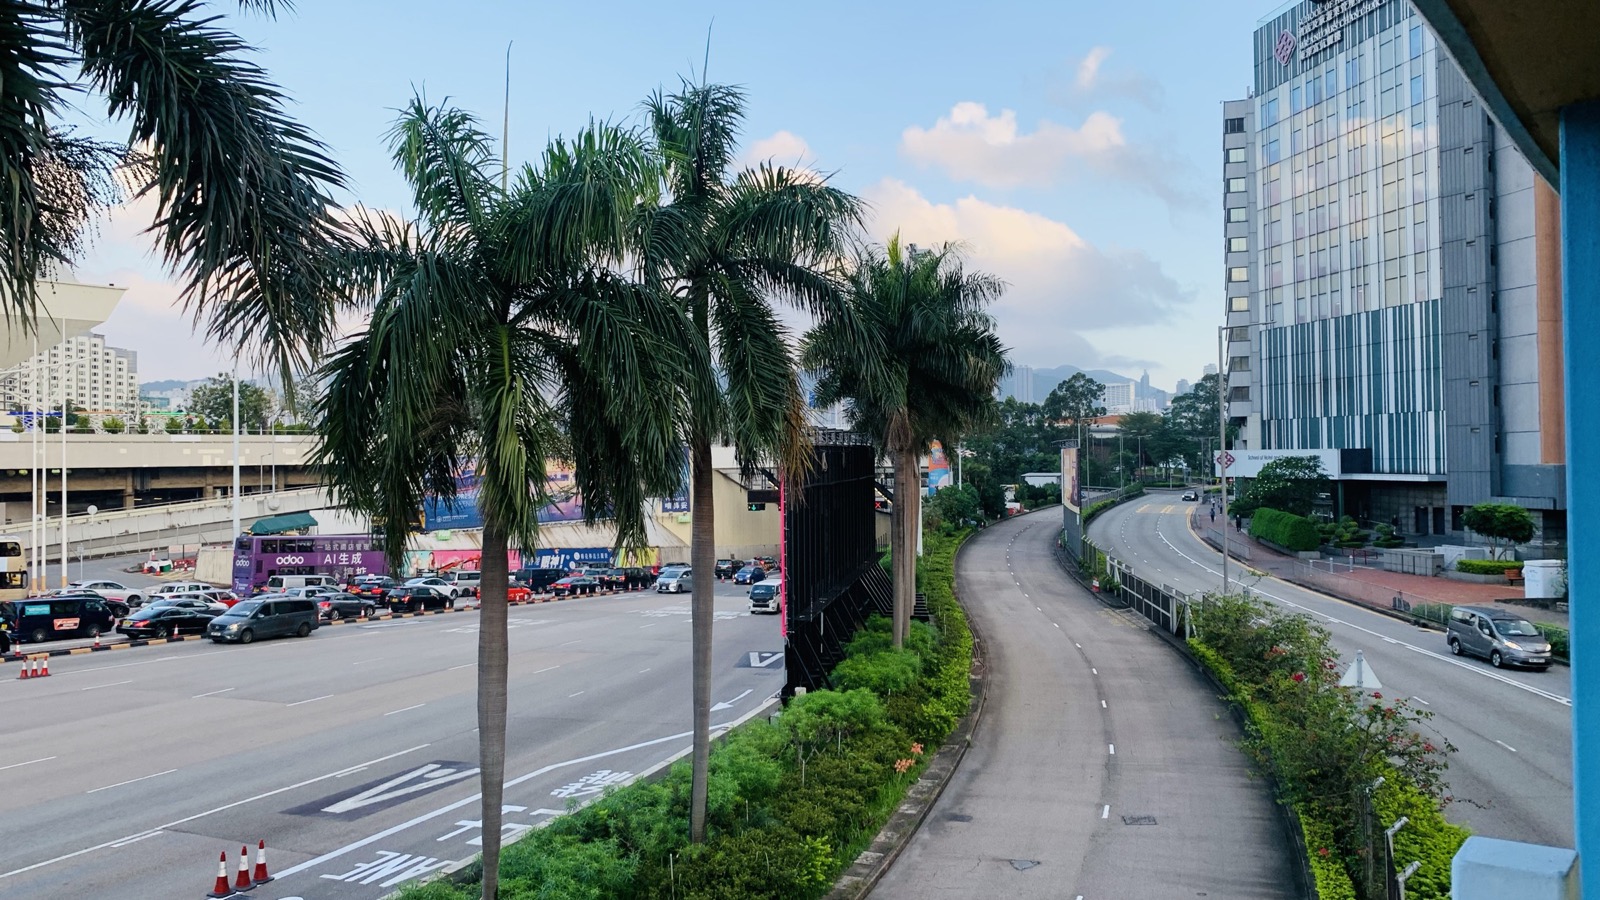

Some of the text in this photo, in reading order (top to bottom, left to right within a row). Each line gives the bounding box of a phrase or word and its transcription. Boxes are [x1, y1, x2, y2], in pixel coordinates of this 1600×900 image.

[235, 558, 250, 567] odoo
[276, 554, 304, 565] odoo
[323, 552, 363, 565] AI生成
